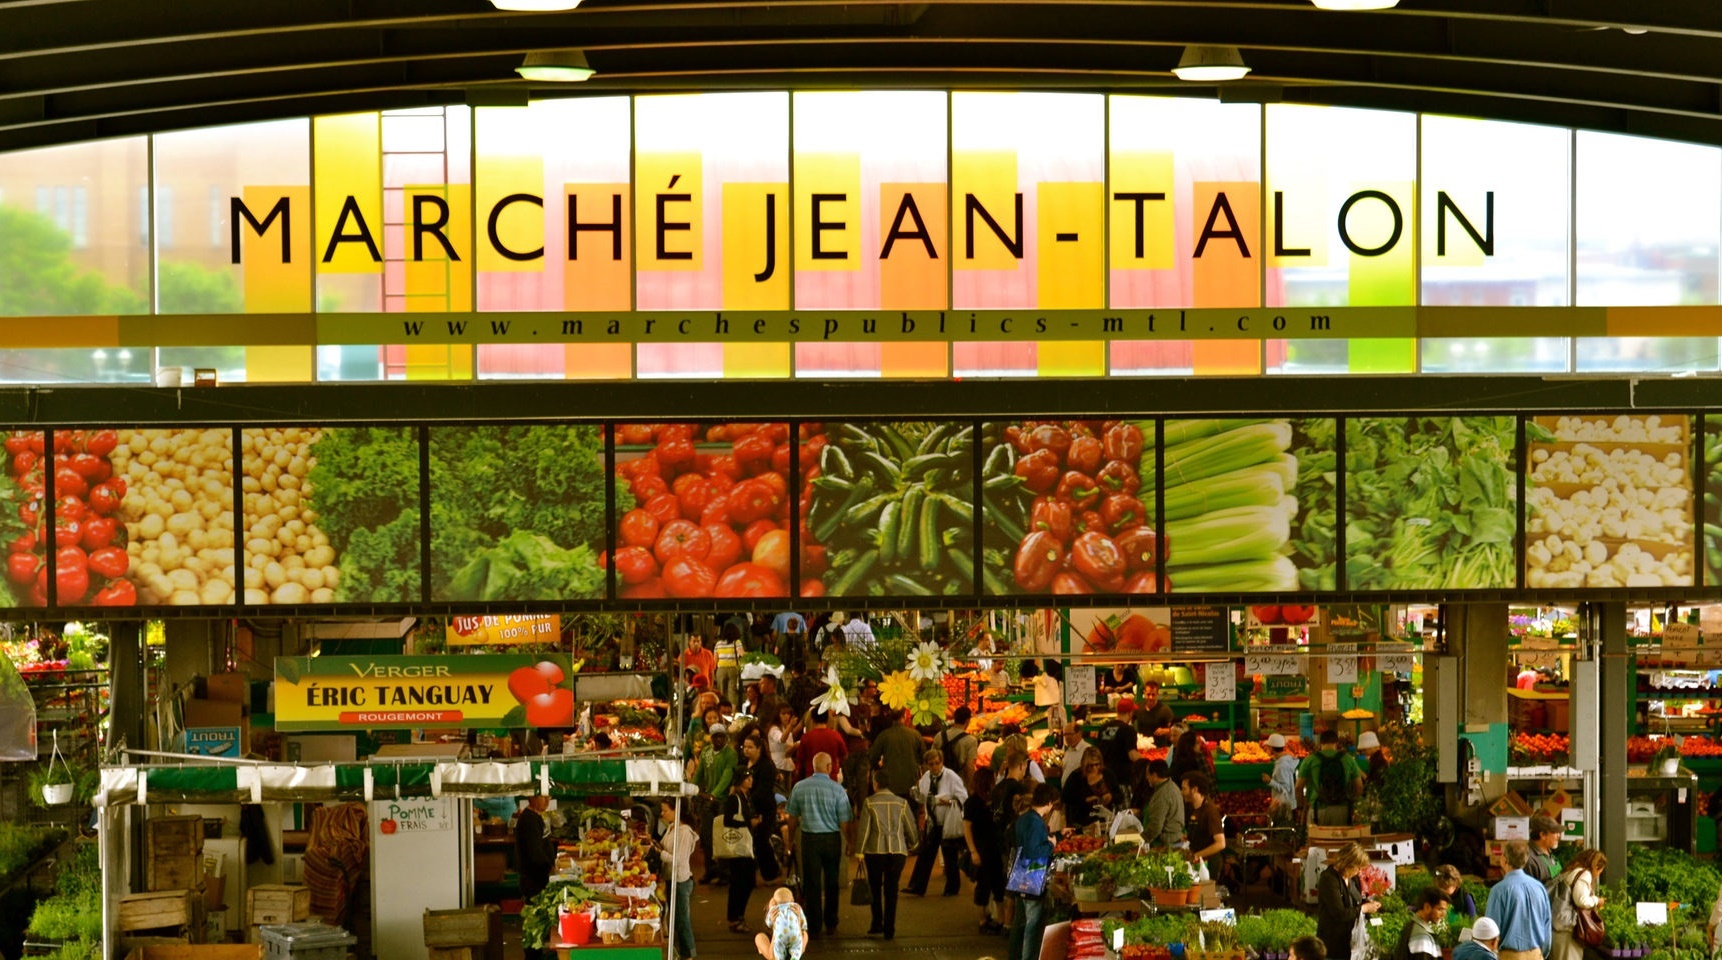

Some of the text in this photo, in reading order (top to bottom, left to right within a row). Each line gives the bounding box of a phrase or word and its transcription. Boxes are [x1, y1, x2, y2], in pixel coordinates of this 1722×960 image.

[230, 175, 1495, 283] MARCHÉ JEAN-TALON
[403, 311, 1332, 340] www.marchespublics-mtl.com
[457, 616, 479, 633] JUS
[500, 622, 552, 639] 100% PUR
[349, 663, 451, 678] VERGER
[306, 683, 494, 706] ÉRIC TANGUAY
[358, 712, 443, 722] ROUGEMONT
[191, 732, 236, 742] TROUT
[400, 821, 428, 831] FRAIS
